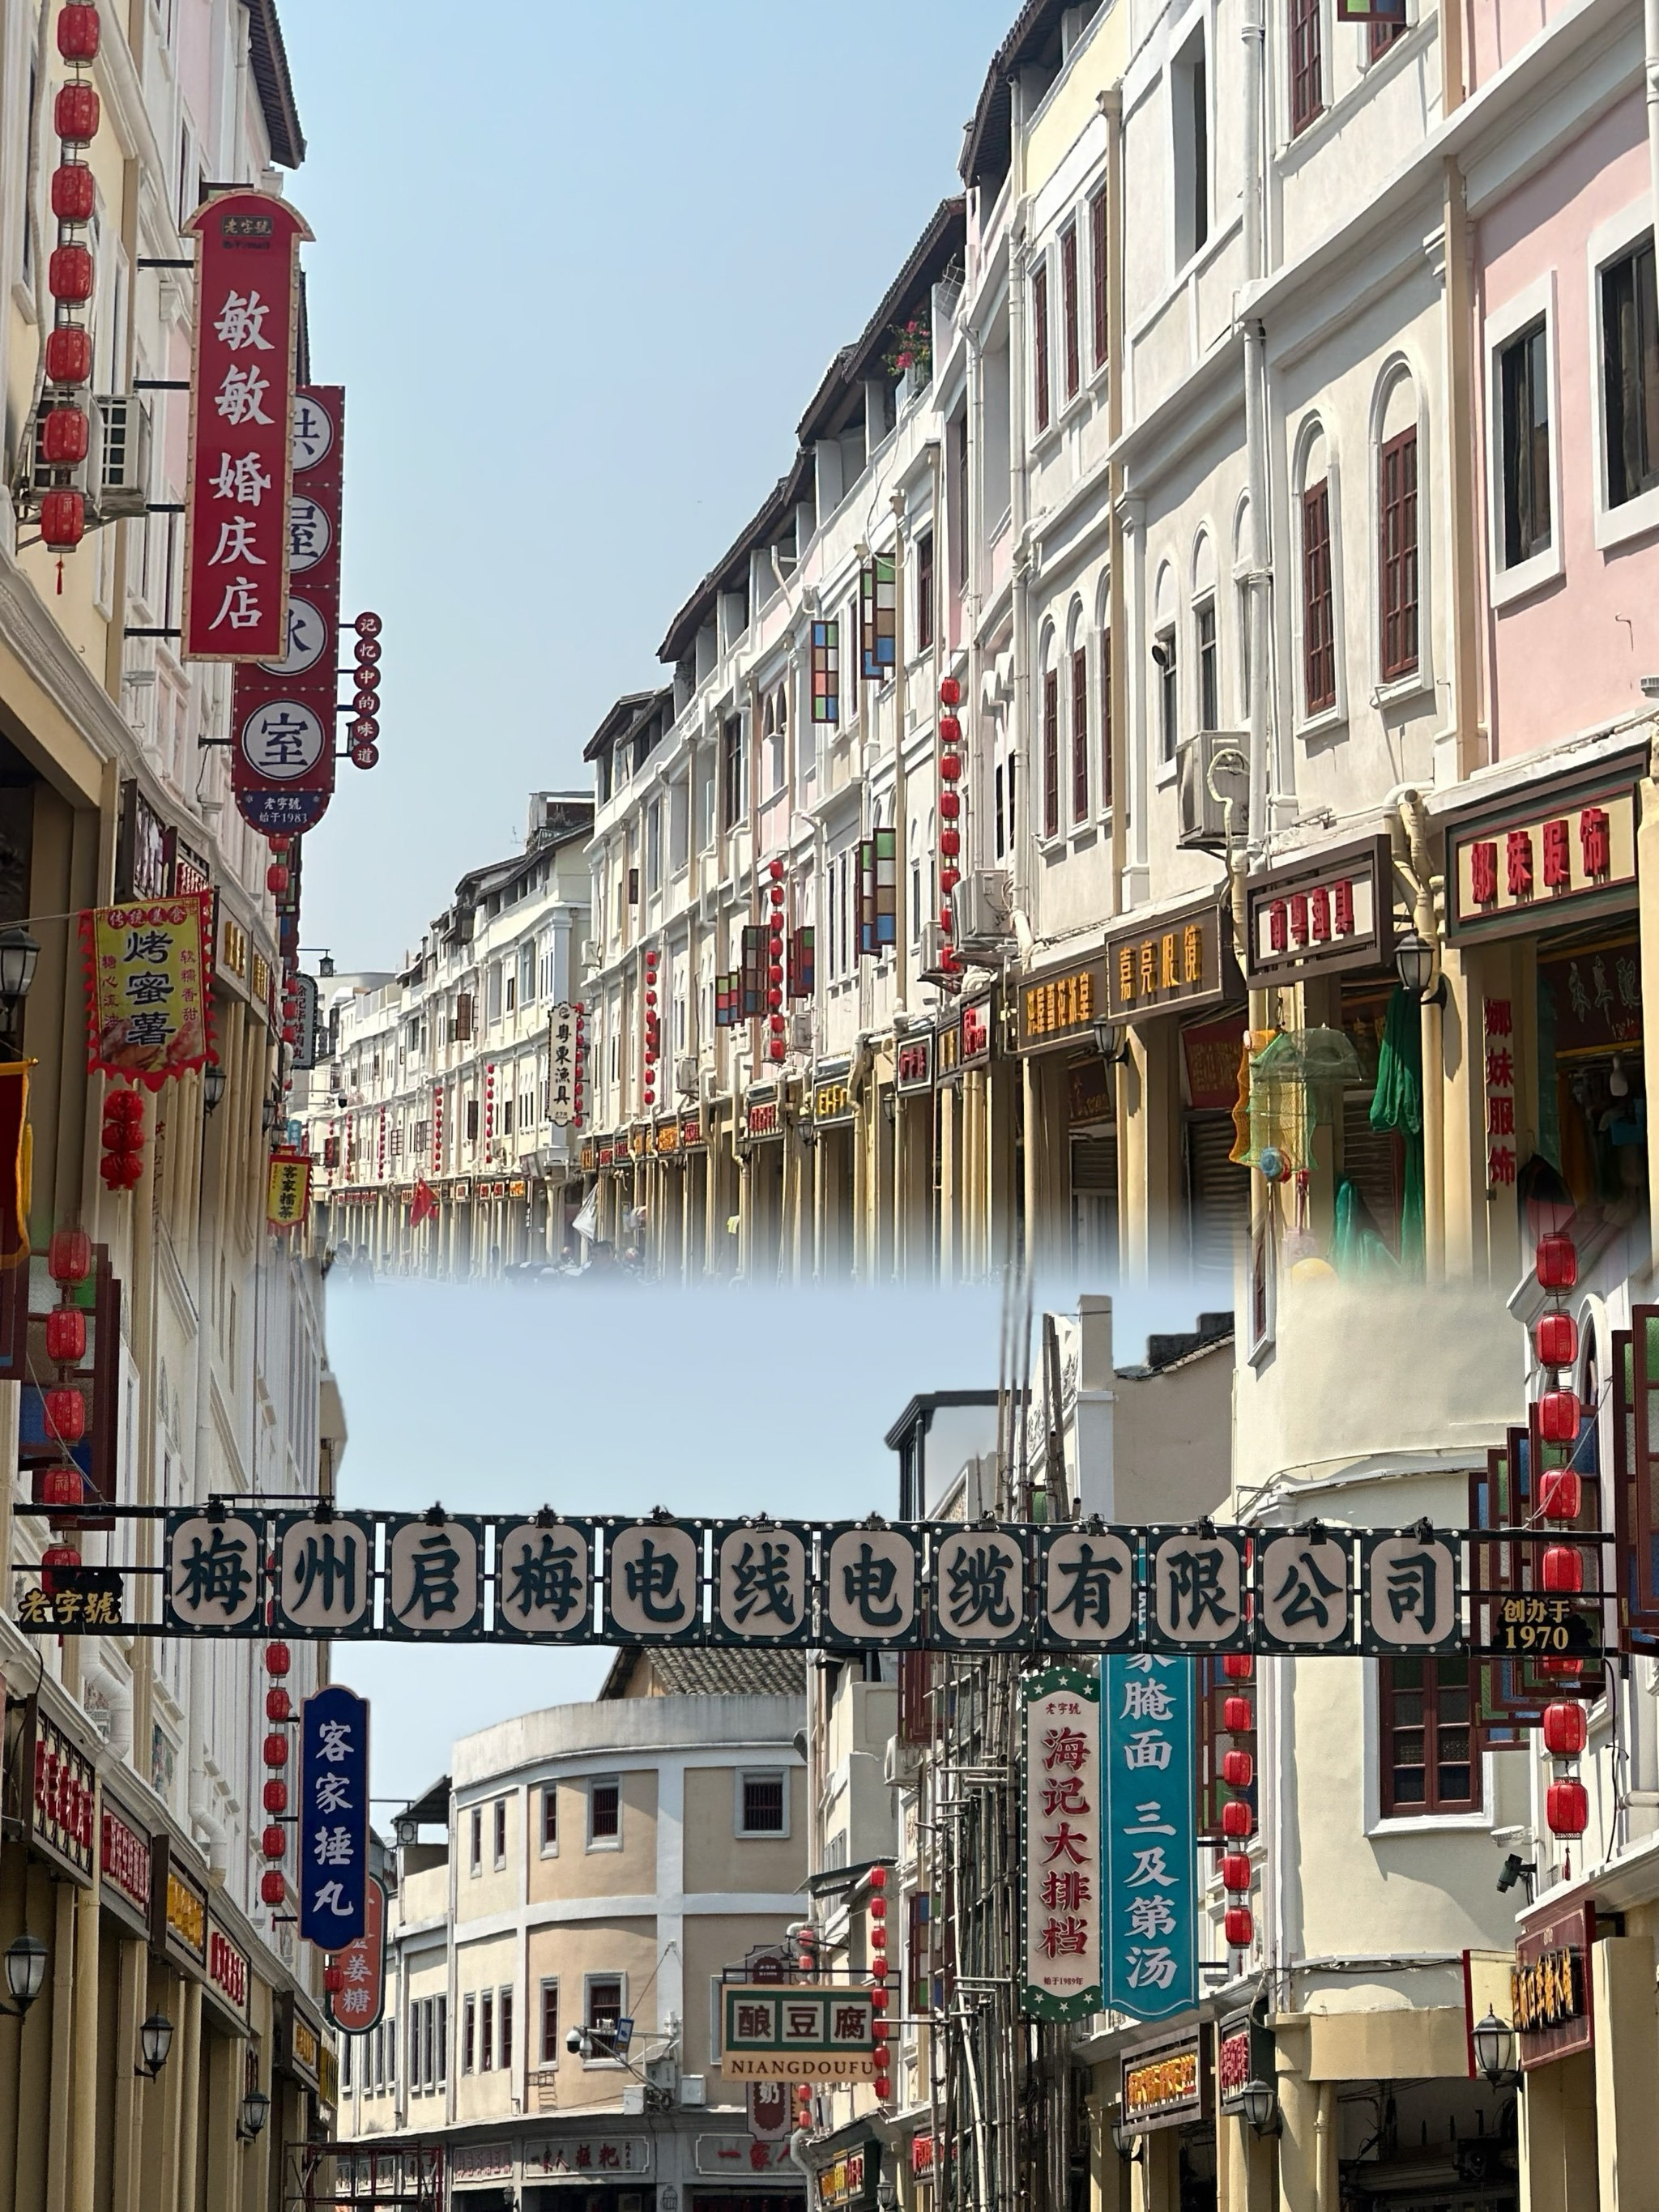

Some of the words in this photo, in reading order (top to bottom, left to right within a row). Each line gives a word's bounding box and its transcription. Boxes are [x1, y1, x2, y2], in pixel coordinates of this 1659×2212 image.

[208, 289, 275, 630] 敏敏婚庆店
[356, 617, 377, 764] 记忆中的味道
[109, 906, 186, 927] 传统美食
[123, 931, 176, 1045] 烤蜜薯
[173, 1526, 1437, 1636] 梅州启梅电线电缆有限公司
[18, 1588, 122, 1626] 老字號
[1503, 1598, 1572, 1623] 创办于
[1505, 1625, 1569, 1650] 1970
[1045, 1703, 1081, 1715] 老字號
[313, 1720, 354, 1918] 客家捶丸
[1038, 1726, 1093, 1961] 海记大排档
[1043, 1974, 1085, 1987] 始于1989年
[738, 2005, 867, 2040] 酿豆腐
[731, 2059, 874, 2076] NIANGDOUFU
